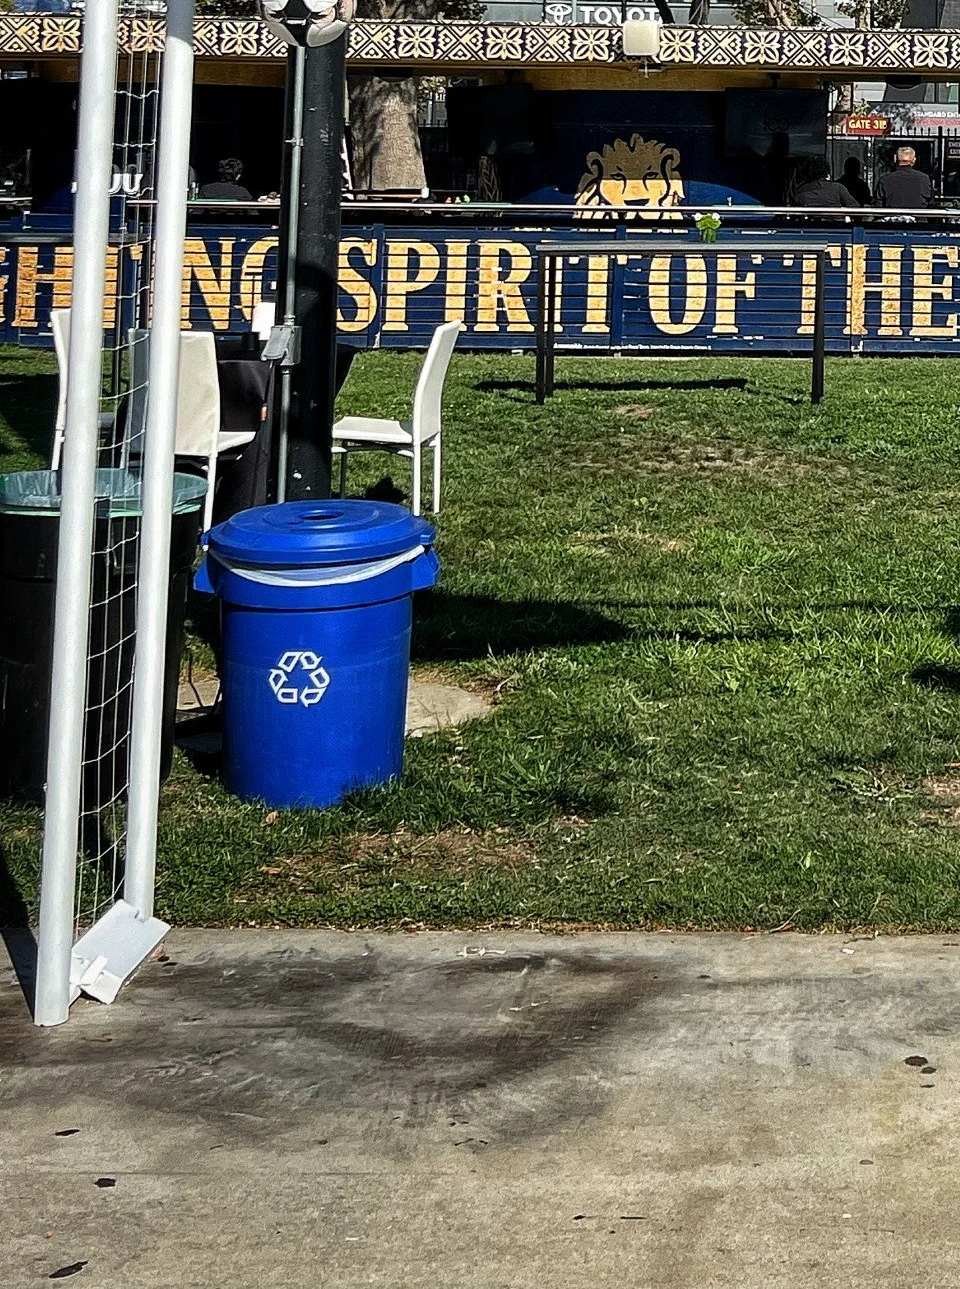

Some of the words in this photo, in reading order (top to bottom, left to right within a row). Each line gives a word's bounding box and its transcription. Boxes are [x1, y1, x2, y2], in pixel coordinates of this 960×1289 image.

[580, 7, 662, 25] TOYOT
[848, 119, 872, 131] GATE
[336, 236, 631, 334] SPIRIT
[648, 252, 756, 335] OF
[781, 243, 958, 337] THE
